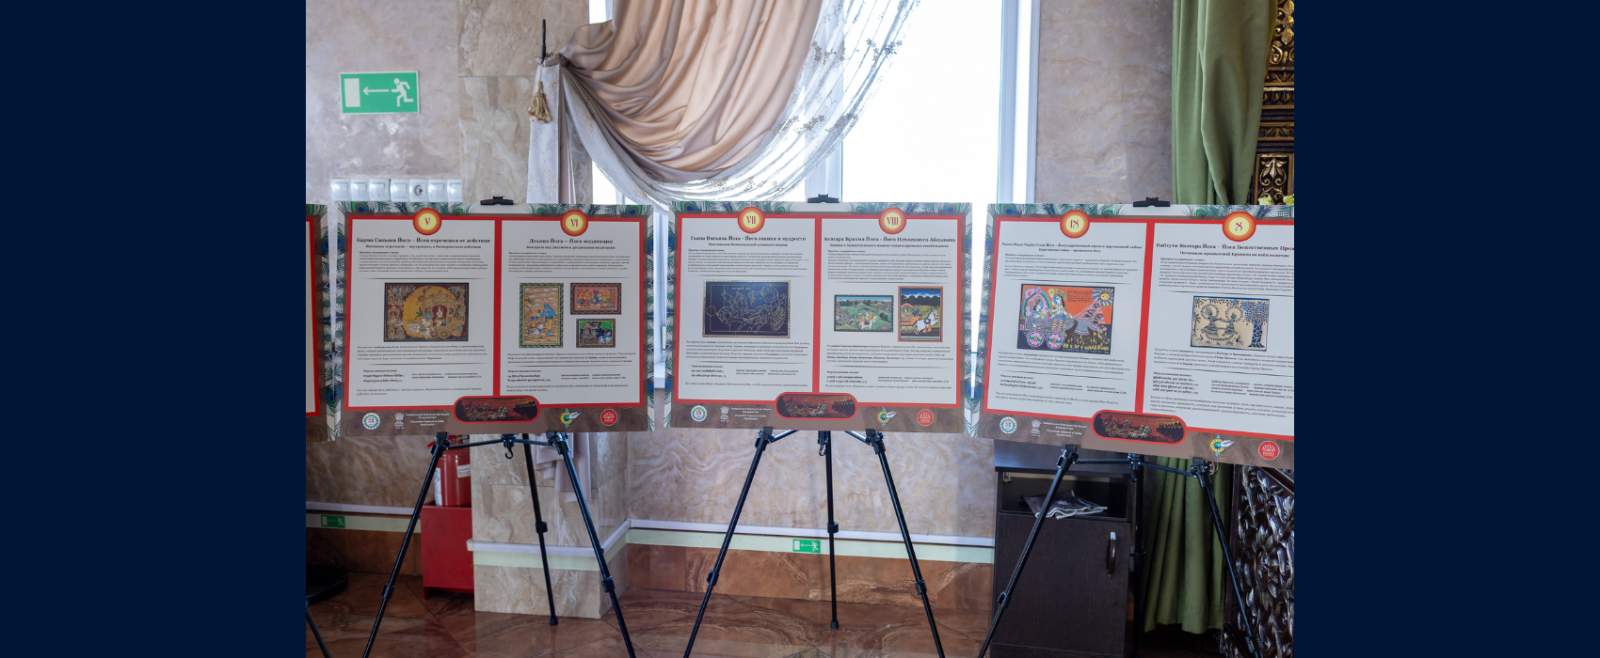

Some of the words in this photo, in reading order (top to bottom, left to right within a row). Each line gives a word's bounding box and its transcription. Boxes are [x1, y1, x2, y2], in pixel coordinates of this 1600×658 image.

[570, 219, 578, 227] VI
[746, 216, 756, 224] VII
[886, 217, 898, 225] VIII
